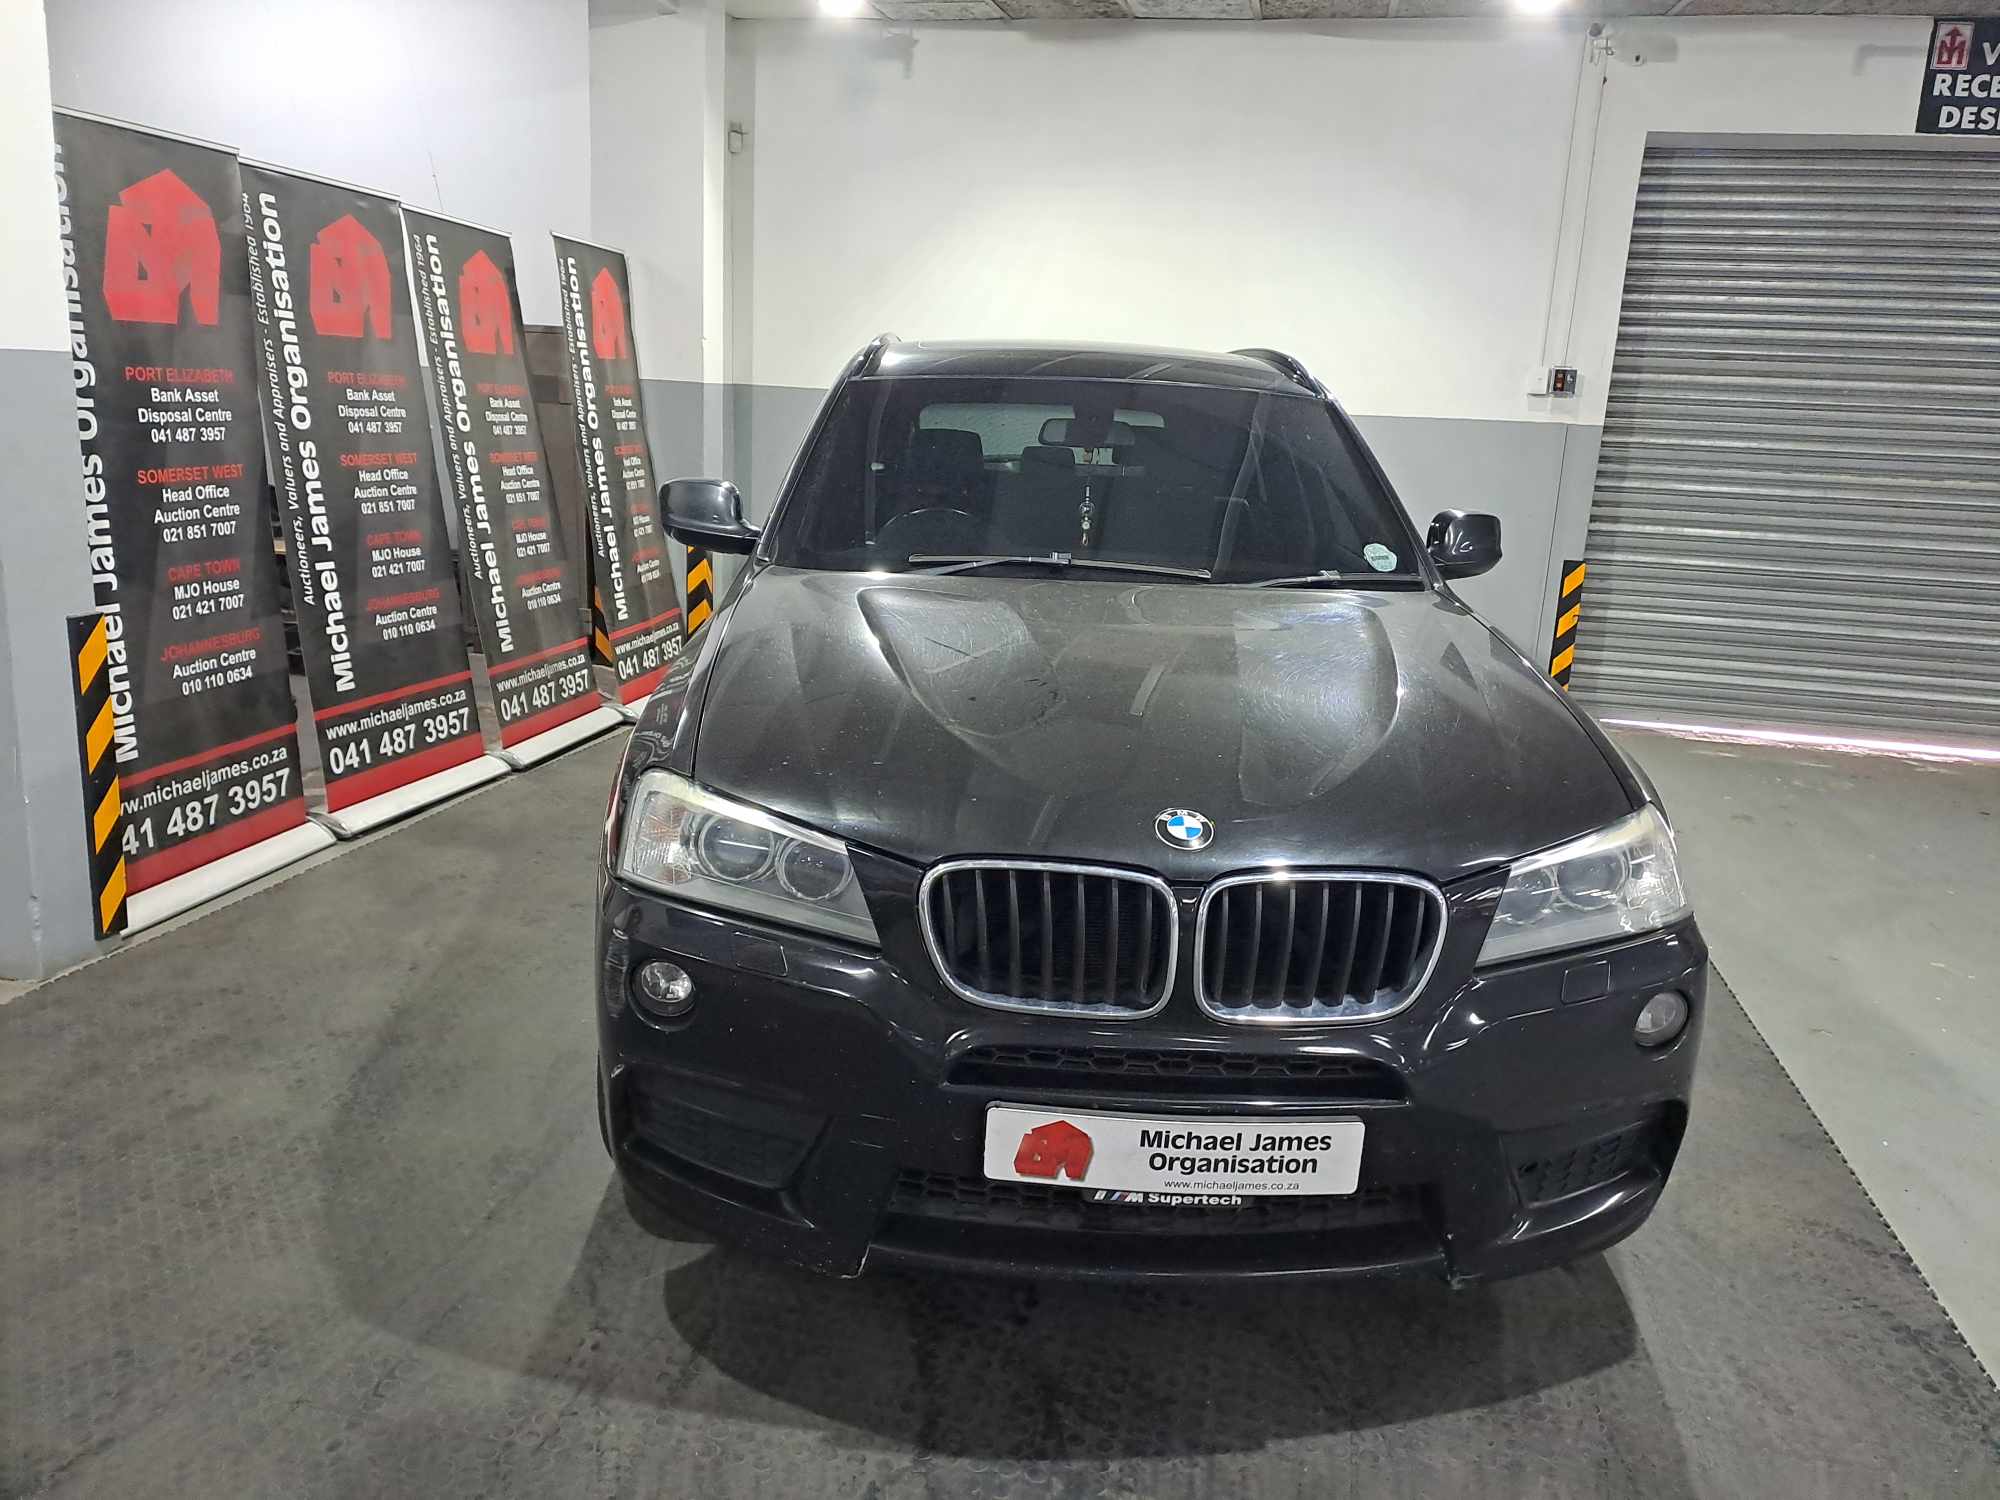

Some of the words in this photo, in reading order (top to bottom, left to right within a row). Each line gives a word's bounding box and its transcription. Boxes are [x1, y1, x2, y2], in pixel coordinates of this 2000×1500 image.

[1938, 106, 2000, 130] DES
[259, 192, 312, 430] Organisation
[418, 269, 438, 344] Established
[426, 234, 471, 433] Organisation
[567, 257, 599, 430] Organisation
[125, 366, 162, 382] PORT
[264, 338, 285, 419] Appraisers
[151, 388, 181, 403] Bank
[185, 388, 219, 402] Asset
[346, 388, 370, 401] Bank
[371, 389, 396, 402] Asset
[435, 356, 453, 423] Appraisers
[138, 408, 192, 425] Disposal
[195, 408, 232, 422] Centre
[338, 405, 378, 420] Disposal
[380, 405, 407, 418] Centre
[151, 428, 172, 443] 041
[175, 428, 196, 442] 487
[200, 427, 226, 441] 3957
[274, 422, 289, 451] and
[348, 421, 364, 433] 041
[366, 421, 382, 433] 487
[384, 421, 402, 433] 3957
[446, 425, 458, 451] and
[137, 466, 208, 485] SOMERSET
[212, 464, 244, 478] WEST
[281, 456, 299, 510] Valuers
[359, 470, 382, 482] Head
[383, 468, 409, 481] Office
[452, 454, 467, 500] Valuers
[464, 442, 491, 534] James
[592, 437, 612, 518] James
[162, 488, 192, 503] Head
[196, 485, 230, 499] Office
[298, 440, 333, 551] James
[354, 487, 388, 499] Auction
[390, 484, 418, 497] Centre
[154, 508, 200, 524] Auction
[203, 503, 240, 517] Centre
[361, 502, 377, 514] 021
[379, 500, 394, 513] 851
[397, 499, 416, 512] 7007
[82, 453, 118, 592] James
[163, 528, 184, 543] 021
[187, 525, 208, 540] 851
[211, 521, 236, 536] 7007
[372, 548, 391, 562] MJO
[393, 546, 421, 559] House
[463, 504, 483, 580] Auctioneers,
[293, 516, 315, 605] Auctioneers,
[372, 565, 387, 578] 021
[389, 562, 404, 575] 421
[406, 559, 425, 573] 7007
[604, 525, 629, 620] Michael
[174, 583, 200, 600] MJO
[203, 579, 240, 595] House
[480, 542, 514, 653] Michael
[172, 604, 193, 620] 021
[196, 599, 215, 616] 421
[219, 594, 244, 611] 7007
[375, 611, 408, 626] Auction
[409, 605, 437, 619] Centre
[315, 561, 356, 692] Michael
[382, 627, 398, 640] 010
[400, 624, 414, 637] 110
[415, 618, 436, 633] 0634
[173, 656, 217, 679] Auction
[220, 648, 256, 668] Centre
[618, 655, 639, 680] 041
[643, 646, 660, 669] 487
[662, 635, 682, 660] 3957
[182, 679, 201, 696] 010
[204, 673, 224, 691] 110
[227, 666, 254, 684] 0634
[500, 691, 528, 721] 041
[532, 681, 557, 709] 487
[559, 669, 589, 698] 3957
[326, 689, 466, 740] www.michaeljames.co.za
[329, 738, 372, 775] 041
[379, 723, 416, 757] 487
[423, 707, 469, 743] 3957
[120, 747, 287, 816] w.michaeljames.co.za
[166, 794, 220, 837] 487
[228, 767, 291, 815] 3957
[1140, 1130, 1242, 1151] Michael
[1250, 1133, 1332, 1151] James
[1149, 1153, 1318, 1175] Organisation
[1148, 1192, 1242, 1206] Supertech
[1164, 1180, 1299, 1191] www.michaeljames.co.za
